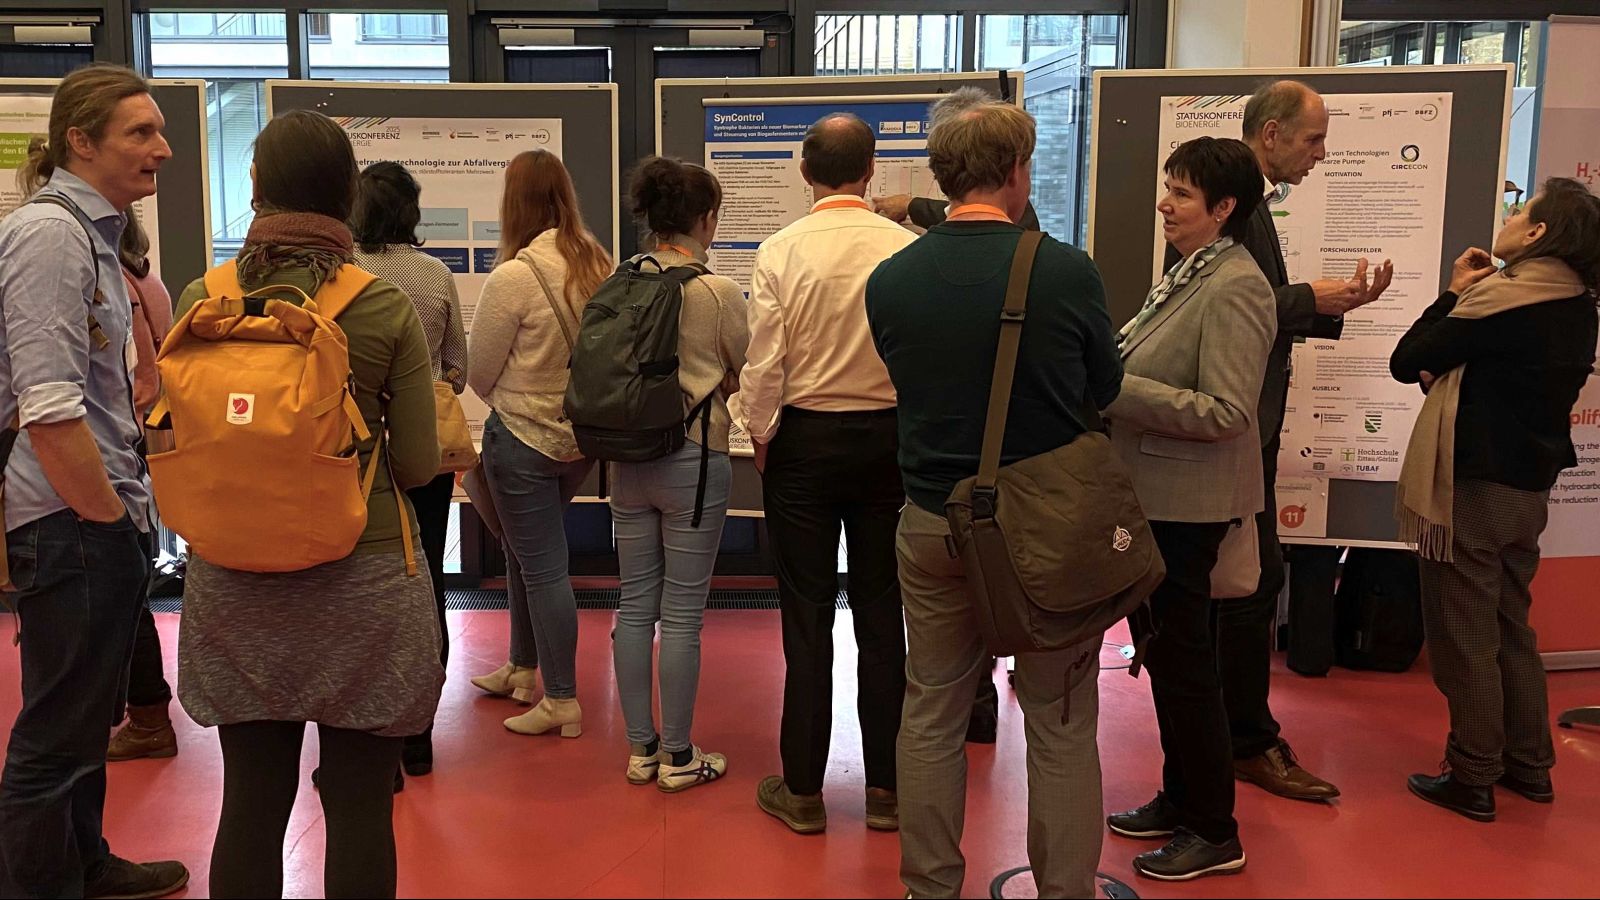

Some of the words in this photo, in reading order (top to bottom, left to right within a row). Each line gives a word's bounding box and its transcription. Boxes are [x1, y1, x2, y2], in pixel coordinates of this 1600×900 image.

[714, 112, 764, 124] SynControl
[1175, 120, 1220, 128] BIOENERGIE
[1357, 448, 1399, 457] Hochschule
[1357, 455, 1399, 463] Zittau/Görlitz
[1285, 511, 1299, 523] 11
